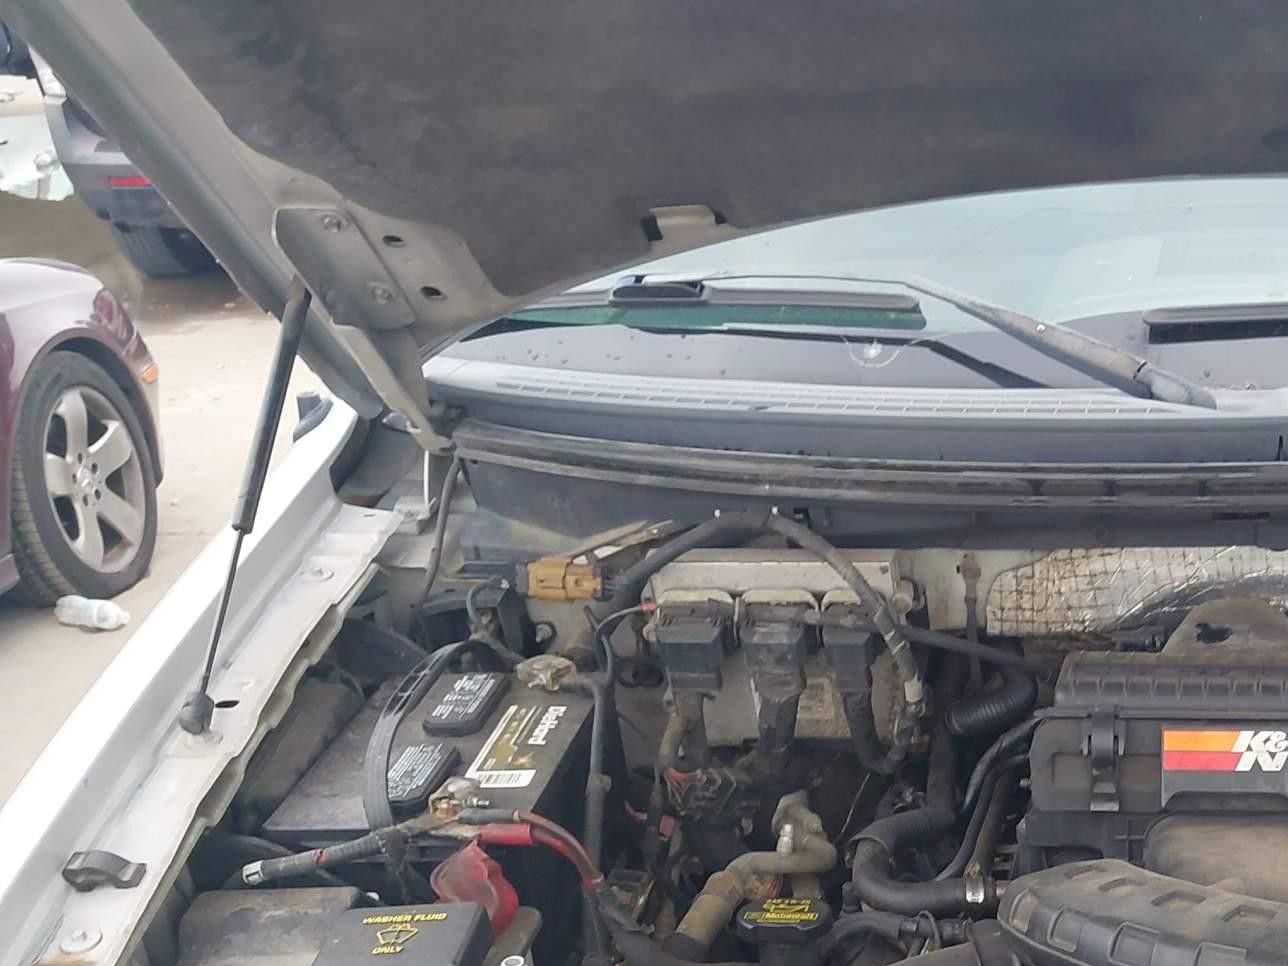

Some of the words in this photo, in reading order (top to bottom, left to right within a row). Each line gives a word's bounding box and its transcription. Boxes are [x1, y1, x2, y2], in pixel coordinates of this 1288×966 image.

[527, 705, 568, 745] DieHard
[362, 913, 411, 925] WASHER
[413, 911, 449, 922] FLUID
[371, 945, 405, 955] ONLY
